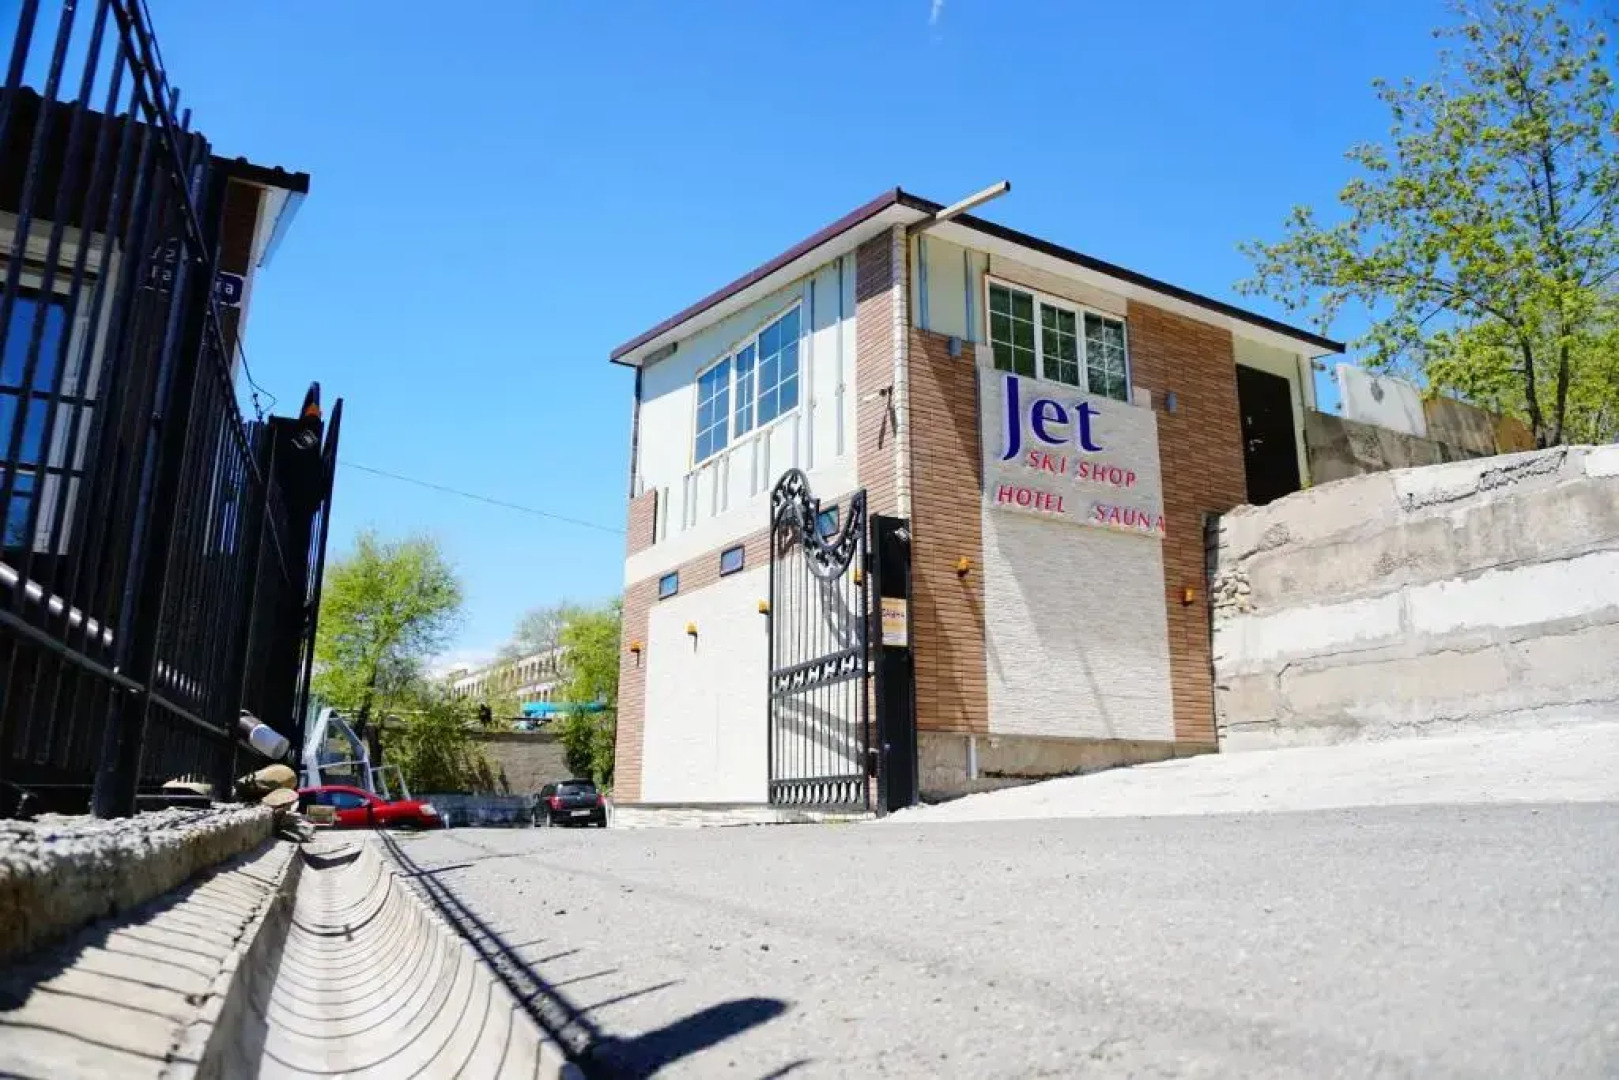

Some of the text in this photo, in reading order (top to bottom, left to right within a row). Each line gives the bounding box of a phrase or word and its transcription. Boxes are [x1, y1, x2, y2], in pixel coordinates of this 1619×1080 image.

[1003, 375, 1103, 460] Jet
[1029, 450, 1136, 488] SKI SHOP
[998, 484, 1166, 532] HOTEL SAUNA
